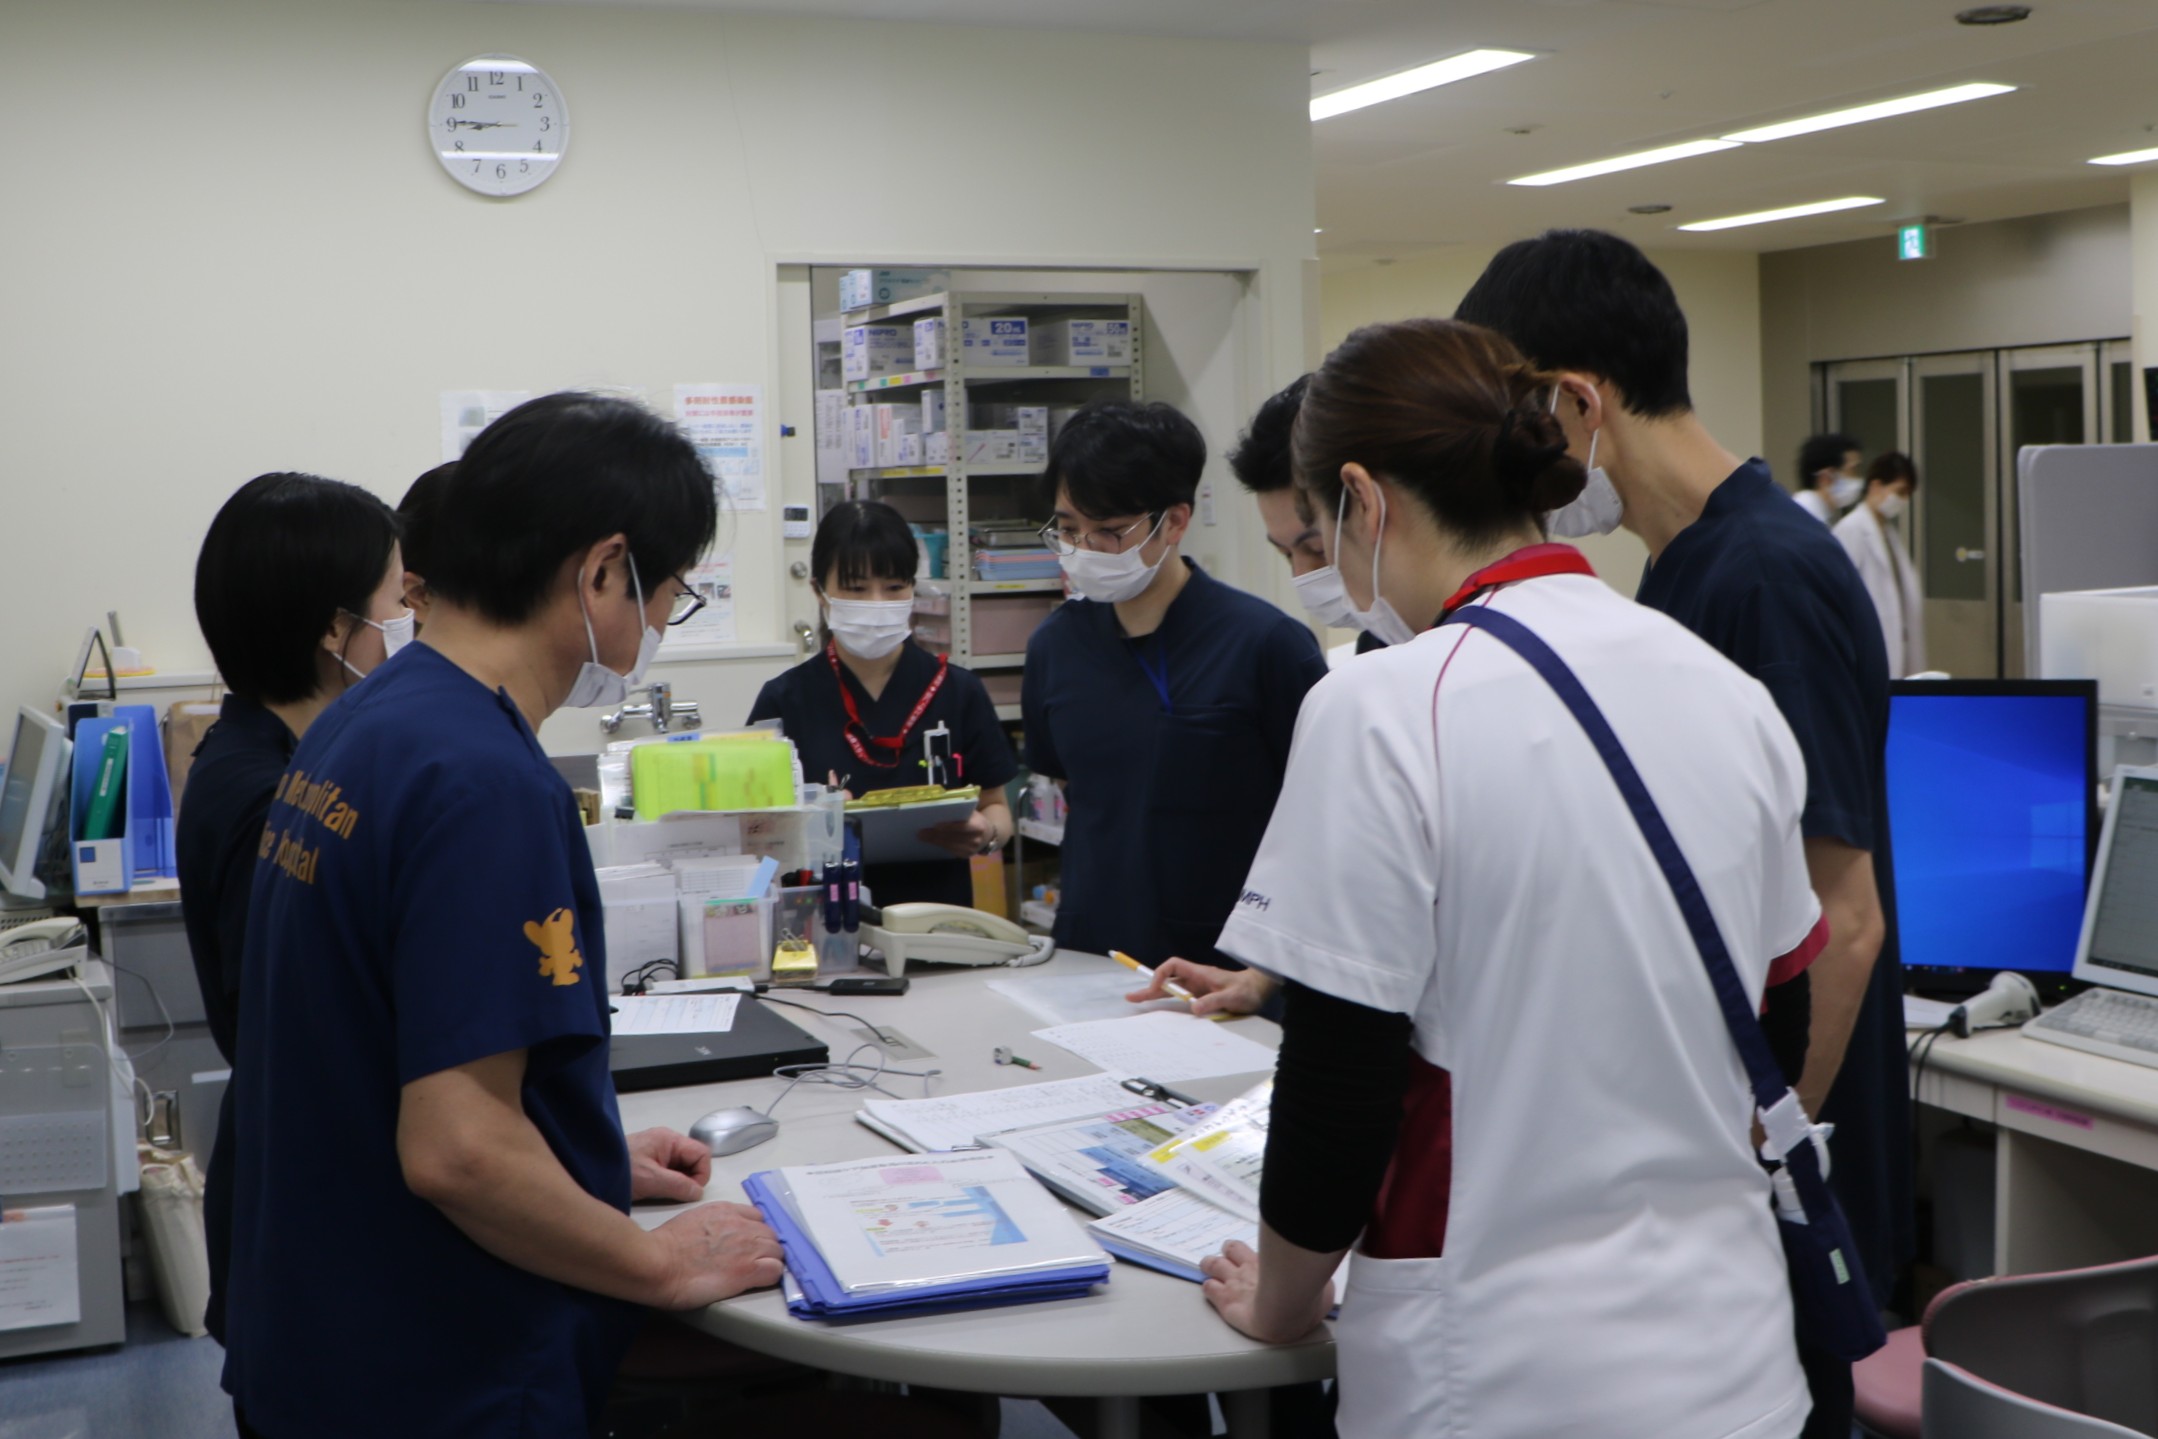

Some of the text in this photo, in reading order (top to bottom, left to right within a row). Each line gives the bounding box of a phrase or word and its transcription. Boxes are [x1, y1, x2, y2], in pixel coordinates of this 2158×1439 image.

[467, 76, 479, 92] 11
[489, 71, 504, 86] 12
[517, 76, 523, 91] 1
[451, 93, 465, 109] 10
[533, 93, 543, 108] 2
[446, 117, 457, 133] 9
[540, 116, 550, 132] 3
[454, 140, 464, 153] 8
[533, 139, 542, 153] 4
[472, 159, 482, 173] 7
[496, 164, 506, 179] 6
[519, 159, 529, 173] 5
